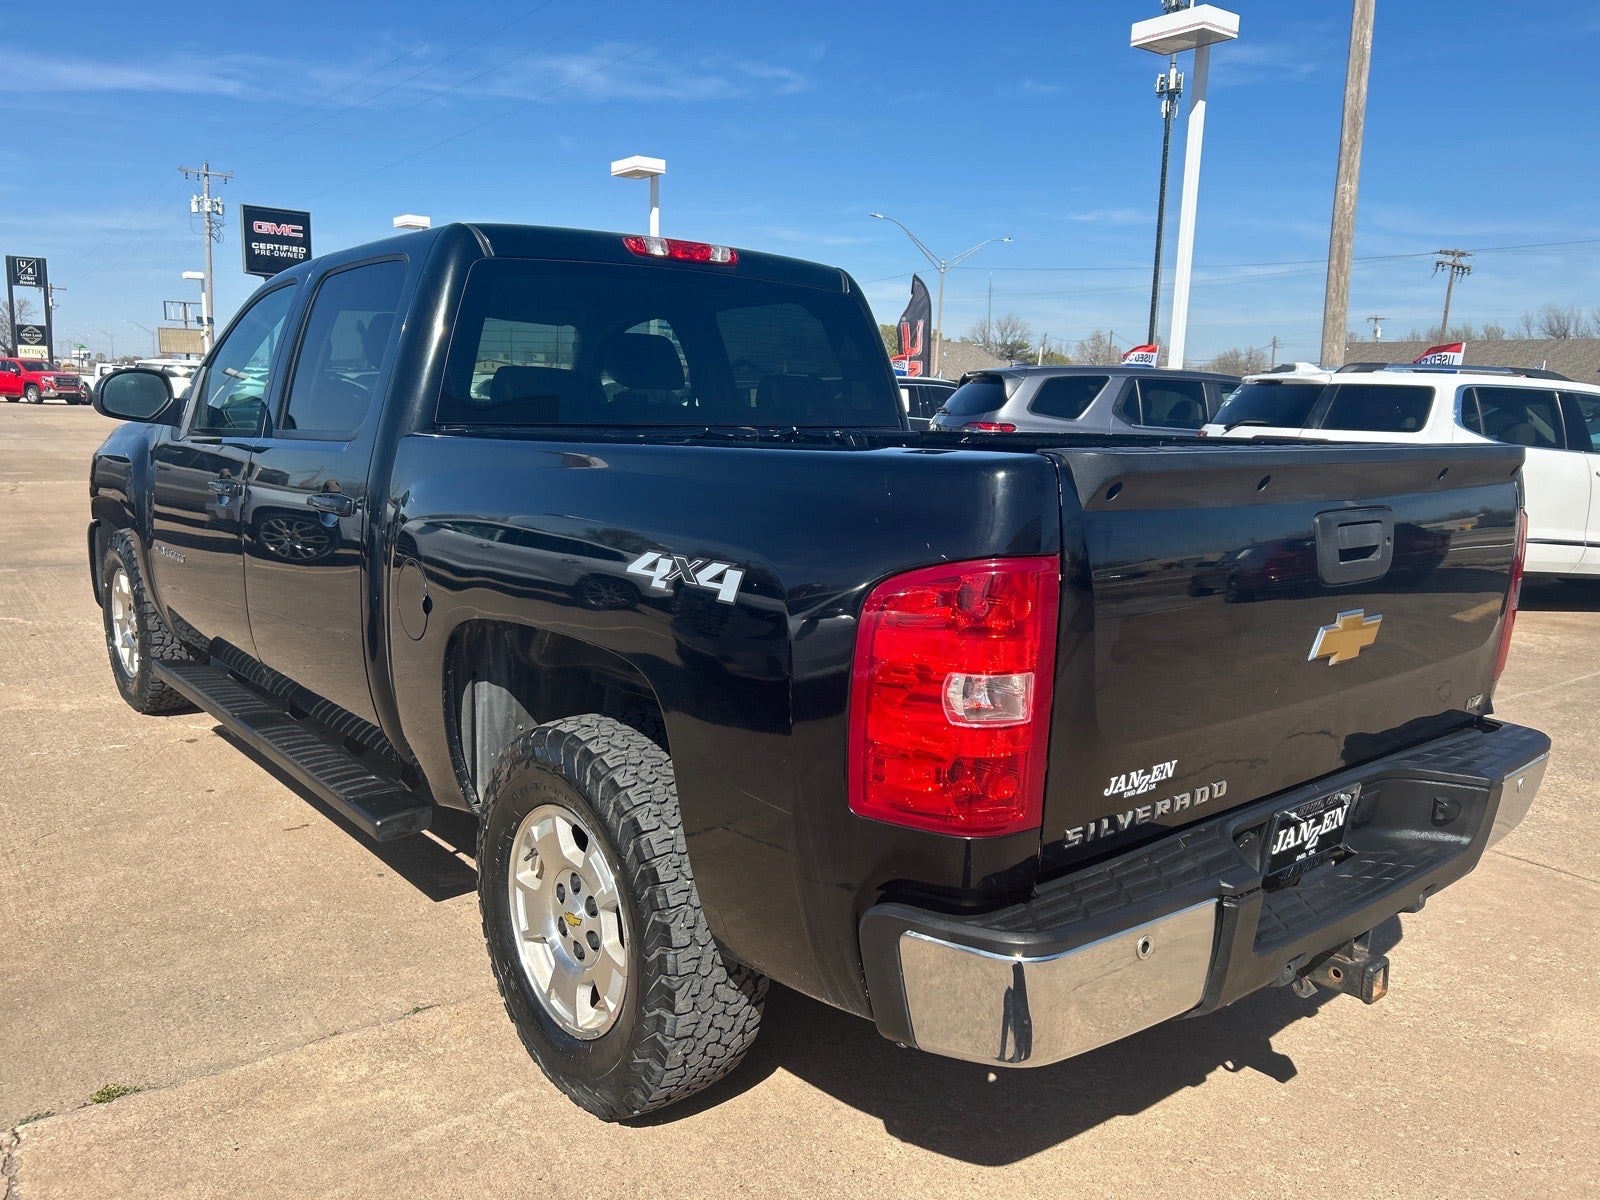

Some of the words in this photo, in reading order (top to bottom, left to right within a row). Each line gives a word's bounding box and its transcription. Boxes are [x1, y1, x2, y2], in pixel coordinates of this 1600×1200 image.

[253, 221, 304, 238] GMC
[251, 242, 307, 254] CERTIFIED
[255, 249, 305, 259] PRE-OWNED
[1103, 760, 1178, 796] JANZEN
[1064, 779, 1229, 849] SILVERADO
[1271, 804, 1350, 855] JANZEN
